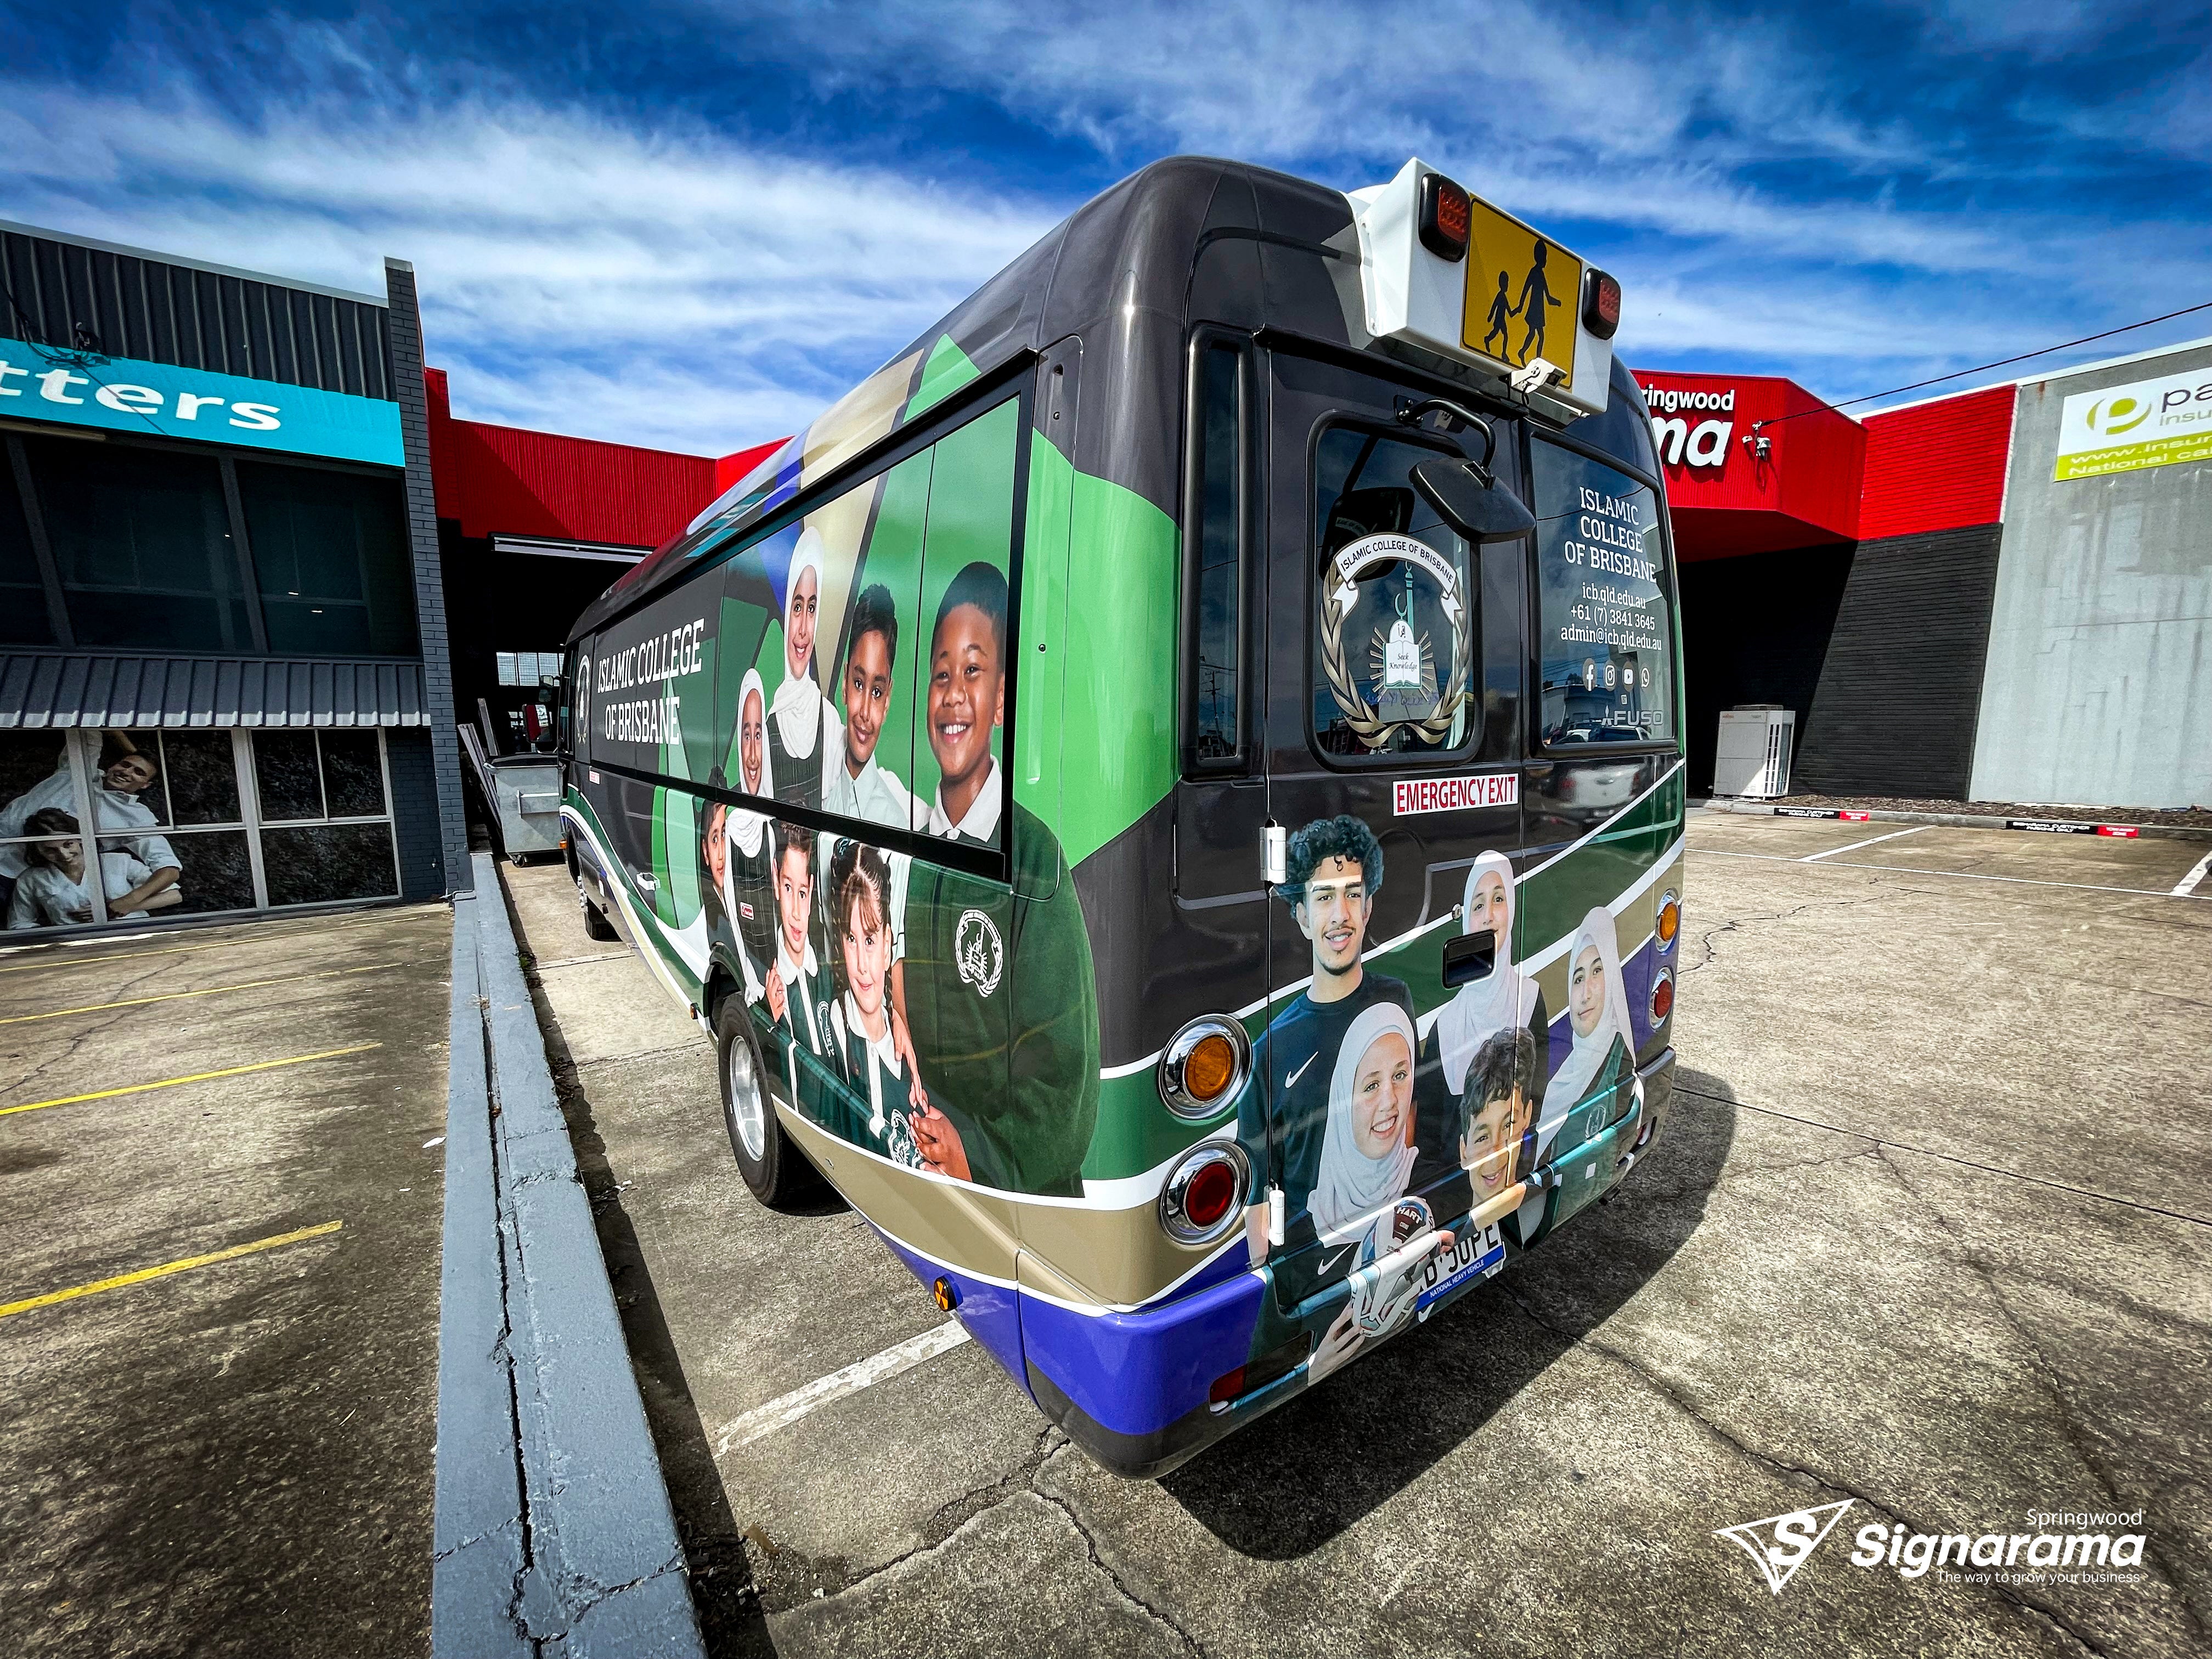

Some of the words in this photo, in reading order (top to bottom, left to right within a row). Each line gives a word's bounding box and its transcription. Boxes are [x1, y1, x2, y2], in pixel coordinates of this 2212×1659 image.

[2068, 453, 2168, 476] National
[1579, 486, 1639, 526] ISLAMIC
[1581, 515, 1643, 553] COLLEGE
[1340, 545, 1372, 572] ISLAMIC
[1373, 540, 1407, 552] COLLEGE
[1409, 544, 1418, 554] OF
[1420, 548, 1453, 584] BRISBANE
[1565, 540, 1585, 565] OF
[1589, 546, 1657, 583] BRISBANE
[1582, 582, 1646, 610] icb.qld.edu.au
[1571, 604, 1591, 621] +61
[1593, 606, 1607, 627] (7)
[1610, 609, 1633, 627] 3841
[1634, 613, 1655, 630] 3645
[1560, 623, 1662, 651] admin@icb.qld.edu.au
[597, 646, 636, 693] ISLAMIC
[637, 618, 705, 685] COLLEGE
[1389, 662, 1418, 672] Knowledge
[605, 704, 617, 740] OF
[618, 696, 680, 745] BRISBANE
[1613, 710, 1663, 725] FUSO
[1397, 778, 1485, 812] EMERGENCY
[1488, 776, 1516, 803] EXIT
[1396, 1207, 1422, 1224] HART
[1430, 1280, 1452, 1298] NATIONAL
[1453, 1269, 1469, 1284] HEAVY
[1467, 1259, 1485, 1274] VEHICLE
